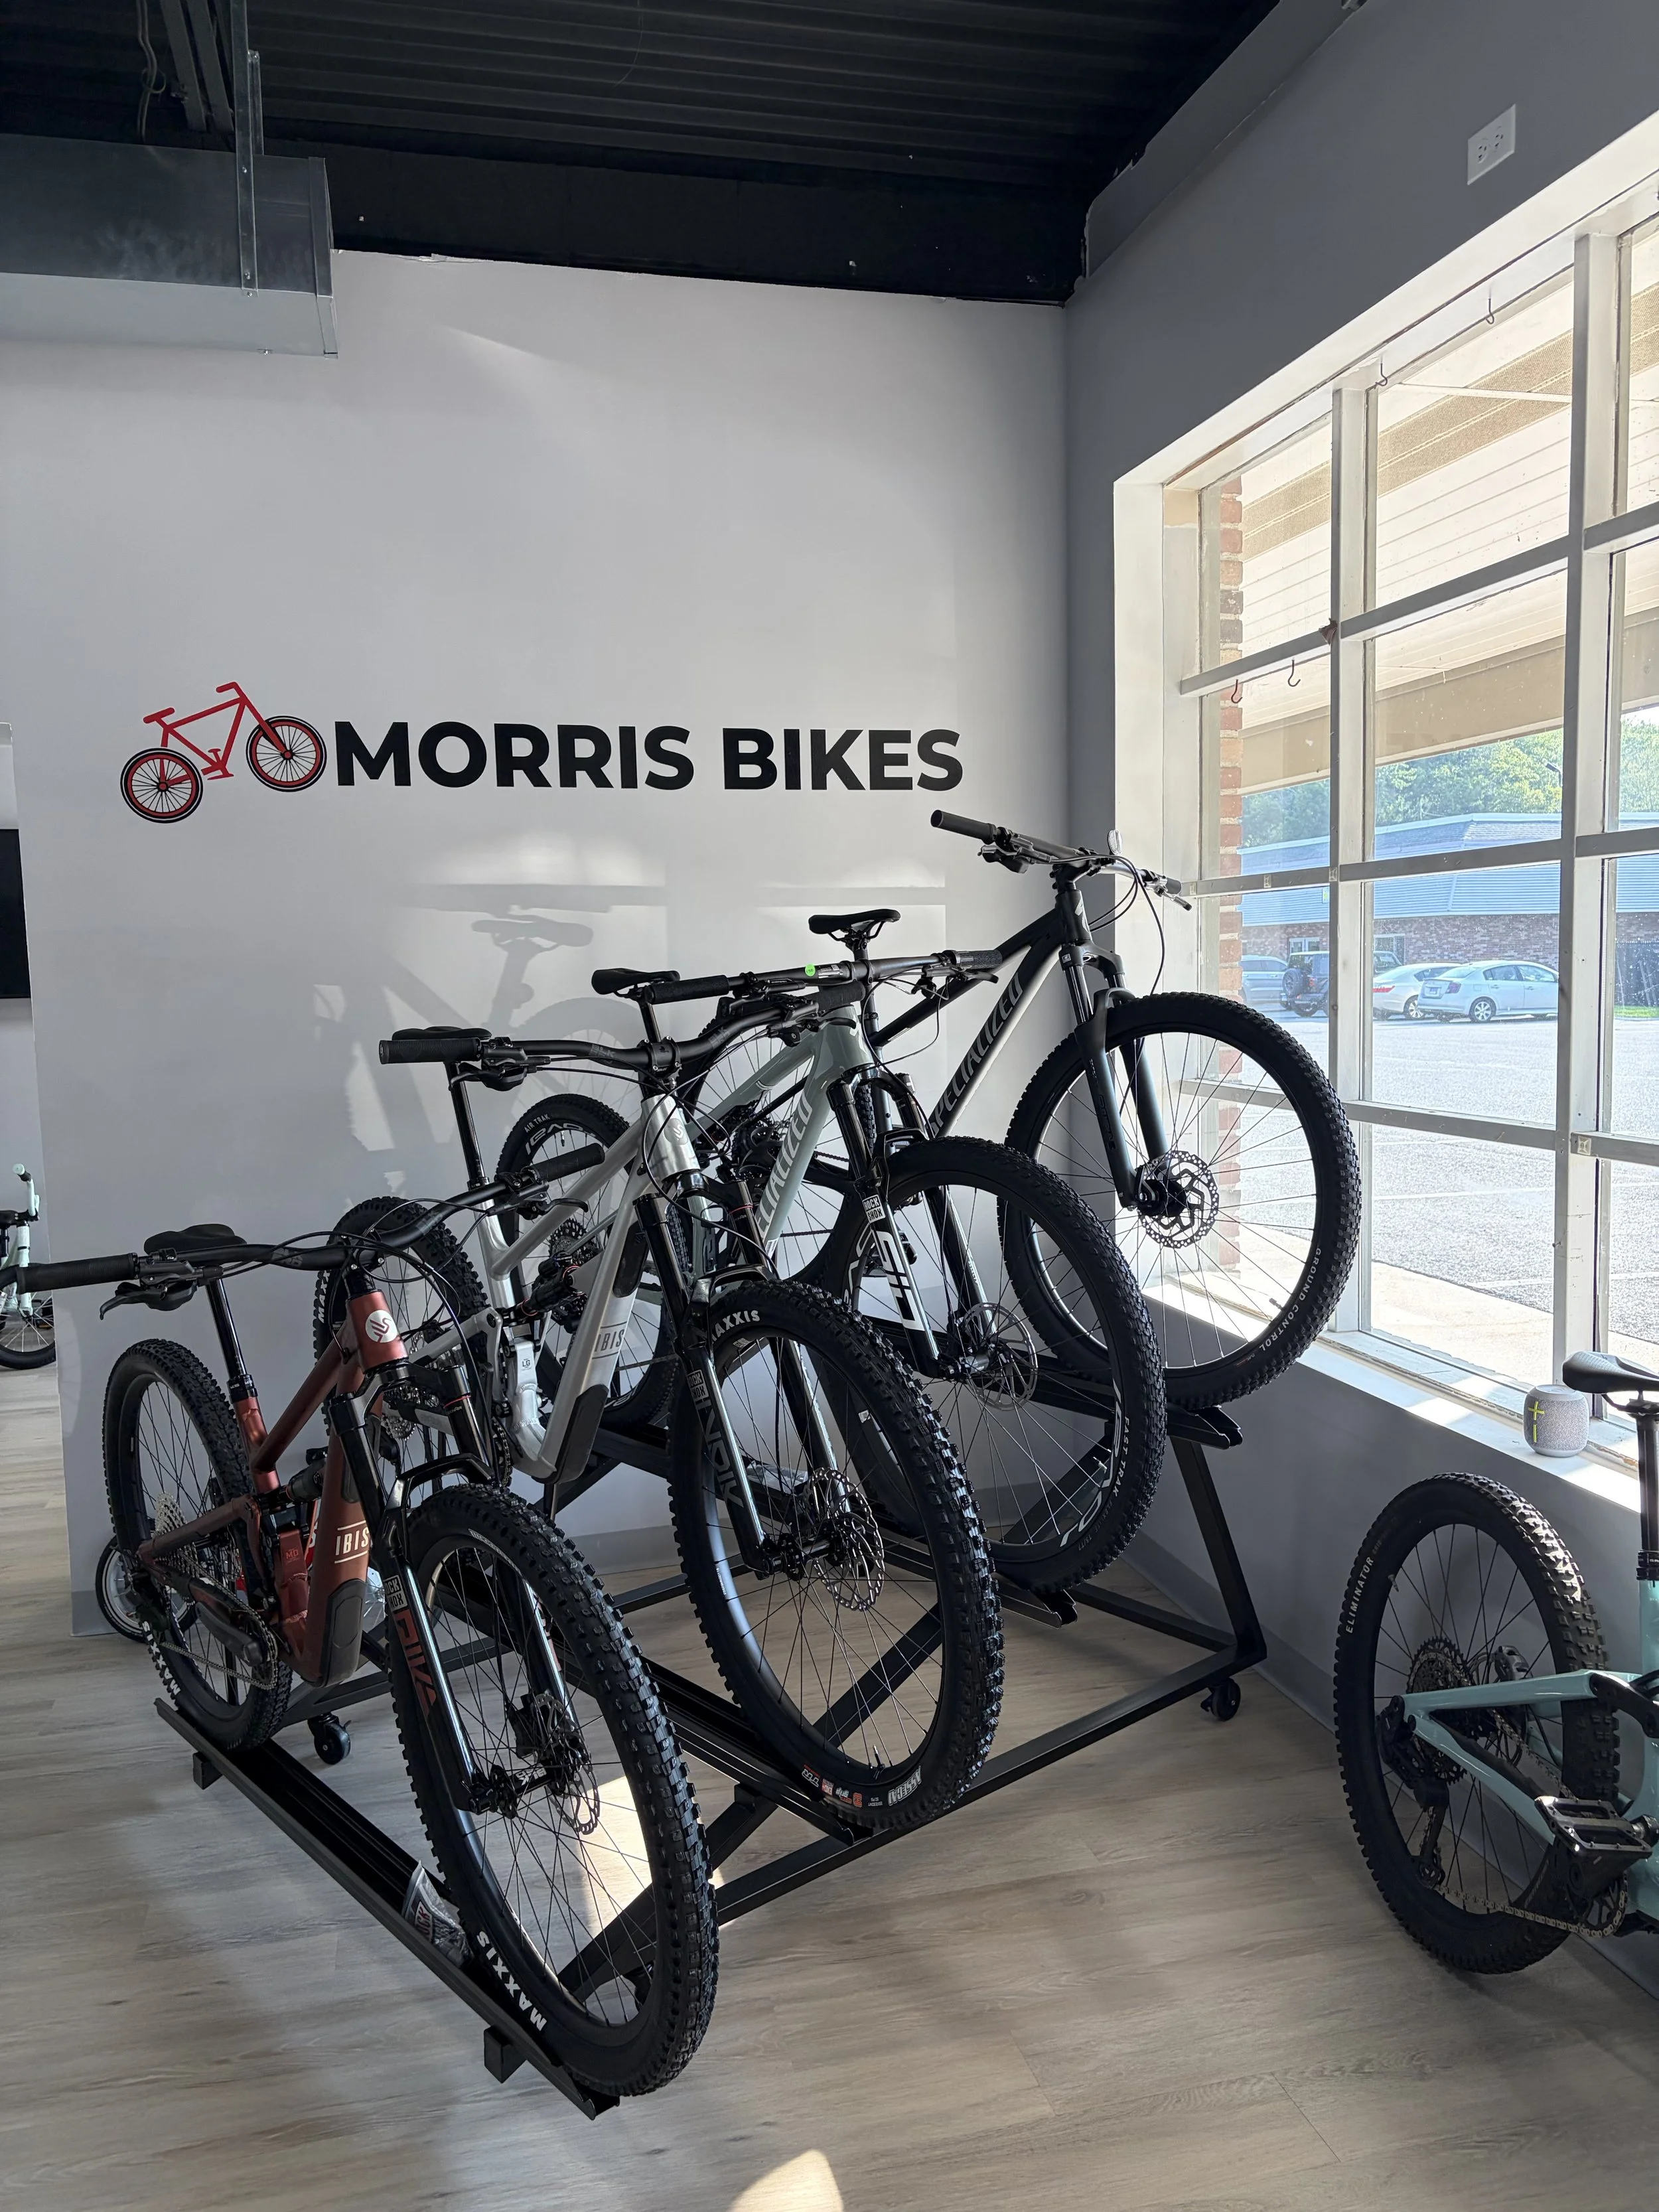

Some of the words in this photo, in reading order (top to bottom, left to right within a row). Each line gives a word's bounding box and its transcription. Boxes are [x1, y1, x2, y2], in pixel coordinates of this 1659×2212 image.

[335, 721, 694, 790] MORRIS
[723, 728, 963, 791] BIKES
[533, 1114, 551, 1125] TRAK
[756, 1090, 813, 1239] ECIALIZED
[319, 1269, 330, 1323] MAXX
[1299, 1248, 1322, 1301] GROUND
[595, 1329, 624, 1353] IBIS
[1259, 1304, 1299, 1352] CONTROL
[1121, 1416, 1130, 1455] FAST
[1112, 1460, 1127, 1497] TRAK
[335, 1526, 370, 1556] IBIS
[1346, 1556, 1374, 1634] ELIMINATOR
[142, 1620, 181, 1696] MAXXIS
[887, 1765, 922, 1806] ASSEGAI
[419, 1905, 432, 1941] OCK
[476, 1930, 548, 2032] MAXXIS
